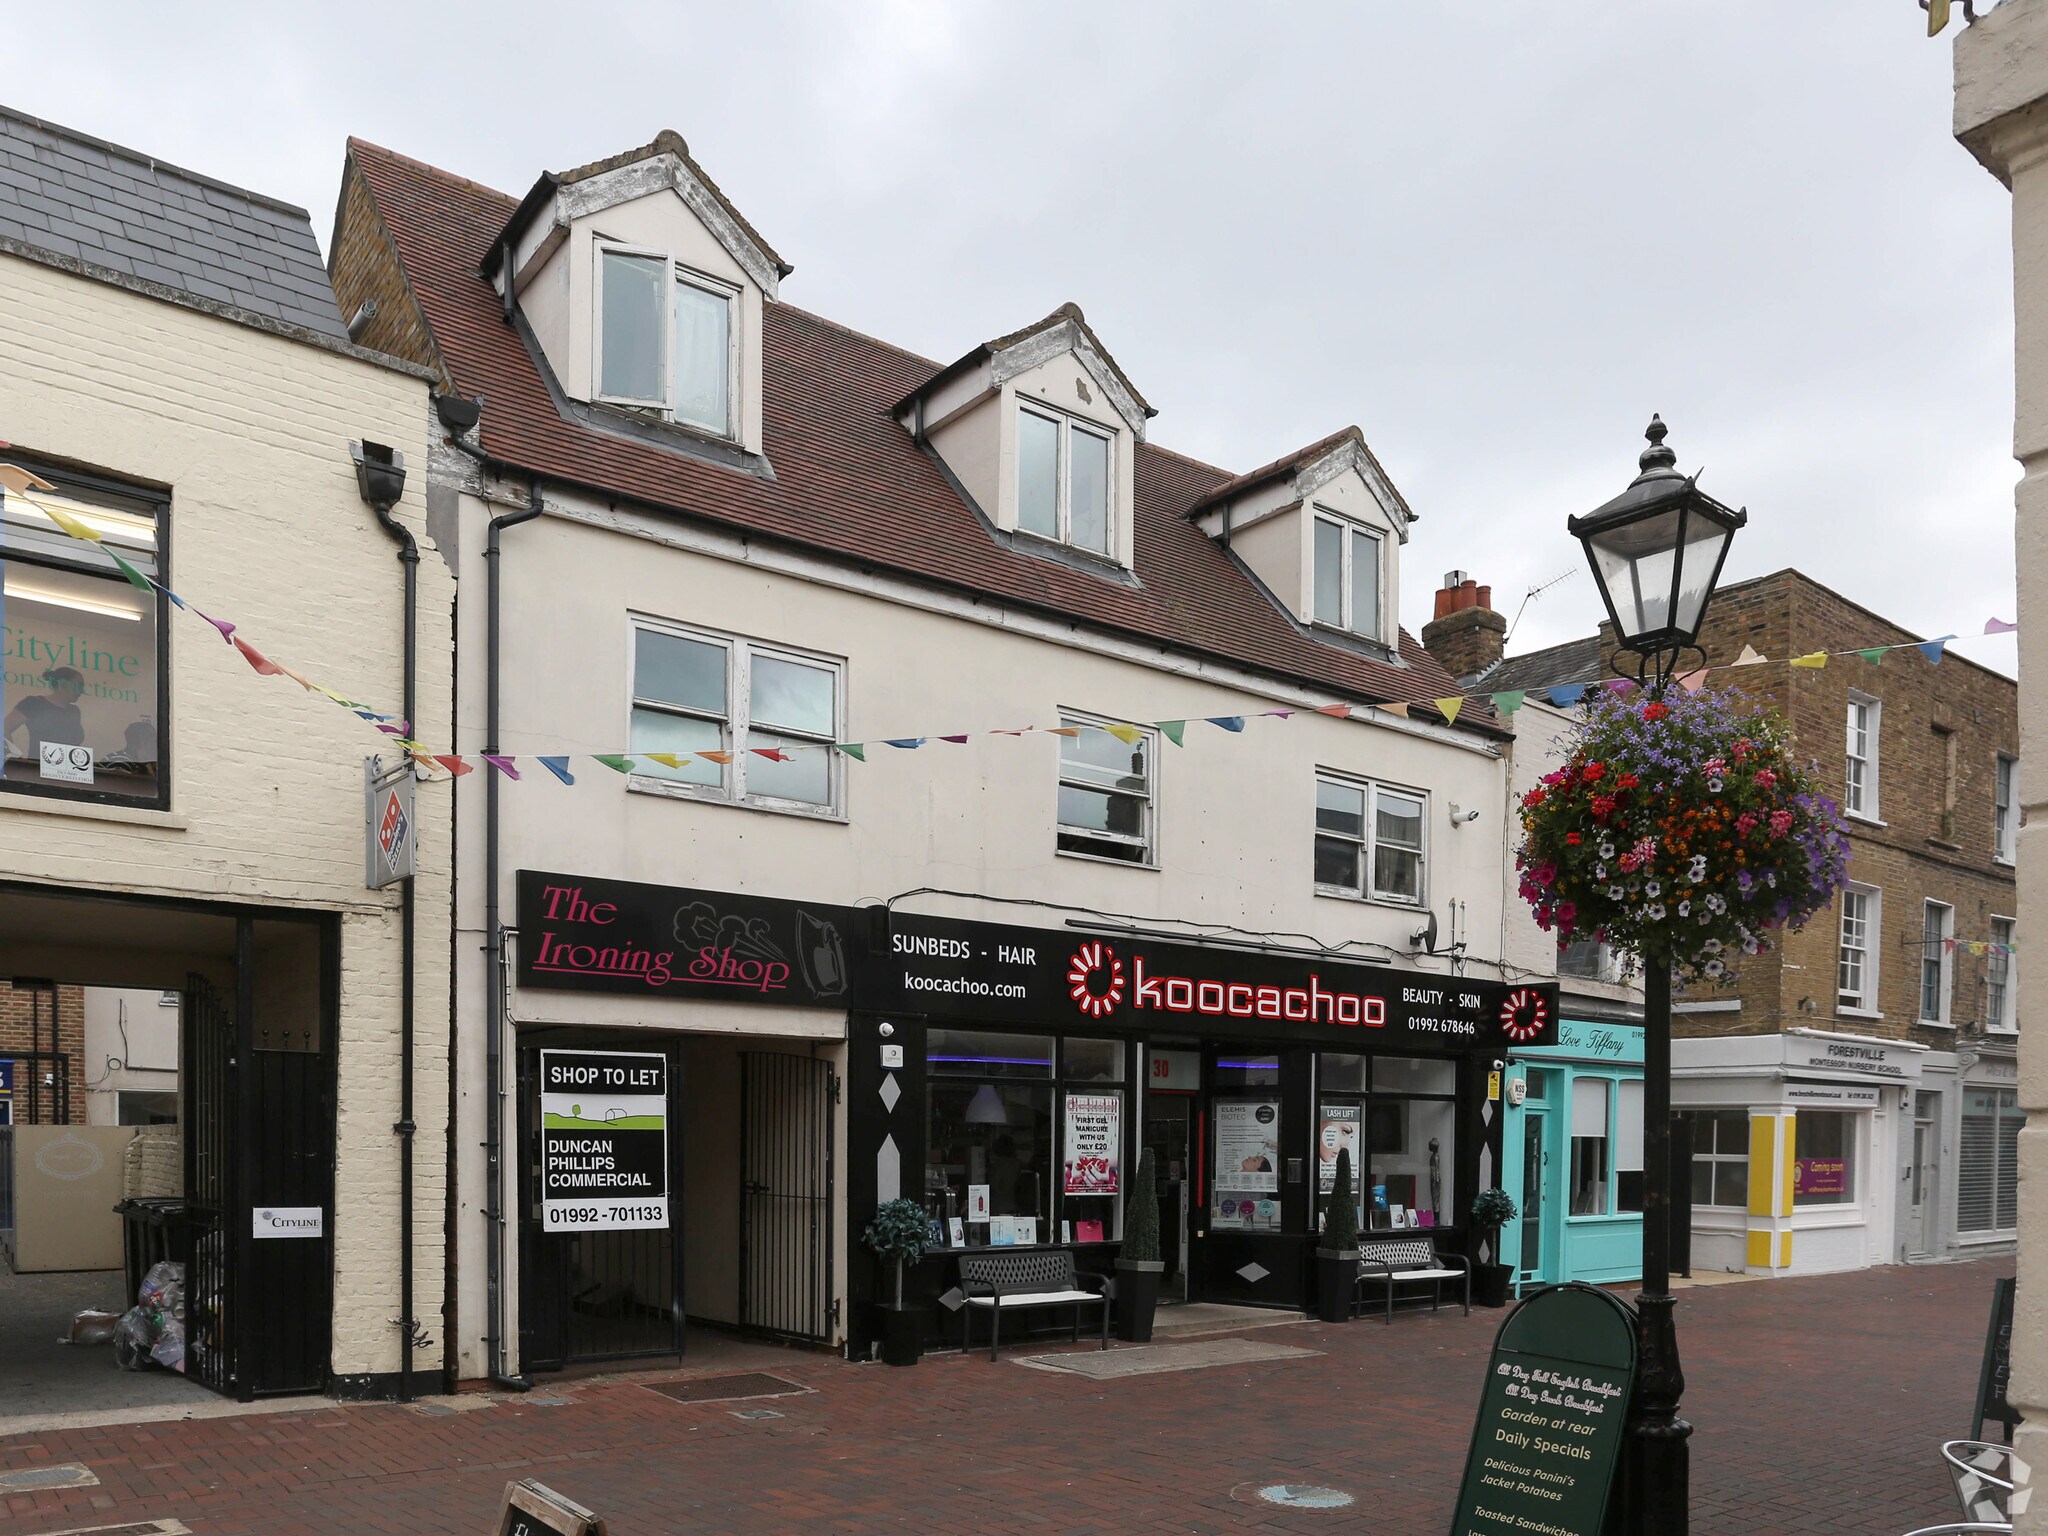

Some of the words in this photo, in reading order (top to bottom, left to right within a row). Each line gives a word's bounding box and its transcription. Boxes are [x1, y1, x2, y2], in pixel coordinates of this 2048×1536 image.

[543, 885, 618, 925] The
[893, 934, 970, 959] SUNBEDS
[998, 945, 1037, 965] HAIR
[534, 932, 674, 986] Ironing
[688, 946, 790, 992] Shop
[904, 972, 1026, 998] koocachoo.com
[1134, 956, 1387, 1028] koocachoo
[1403, 988, 1443, 1005] BEAUTY
[1459, 993, 1481, 1009] SKIN
[1408, 1017, 1438, 1032] 01992
[1440, 1019, 1475, 1035] 678646
[1558, 1026, 1581, 1047] Love
[1586, 1030, 1625, 1056] Tiffany
[1828, 1044, 1885, 1061] FORESTVILLE
[551, 1066, 599, 1084] SHOP
[604, 1068, 625, 1085] TO
[630, 1069, 659, 1085] LET
[1153, 1059, 1169, 1078] 30
[1809, 1058, 1847, 1068] MONTESSORI
[1848, 1061, 1876, 1072] NURSERY
[1877, 1064, 1902, 1074] SCHOOL
[1327, 1109, 1341, 1117] LASH
[1342, 1110, 1354, 1118] LIFT
[549, 1140, 612, 1153] DUNCAN
[549, 1157, 615, 1170] PHILLIPS
[549, 1173, 651, 1187] COMMERCIAL
[1501, 1407, 1548, 1427] Garden
[1551, 1419, 1566, 1430] at
[1567, 1423, 1597, 1436] rear
[1495, 1429, 1530, 1449] Daily
[1533, 1437, 1591, 1460] Specials
[1484, 1458, 1531, 1476] Delicious
[1533, 1469, 1576, 1486] Panini's
[1481, 1474, 1515, 1489] Jacket
[1516, 1482, 1563, 1501] Potatoes
[1474, 1506, 1515, 1524] Toasted
